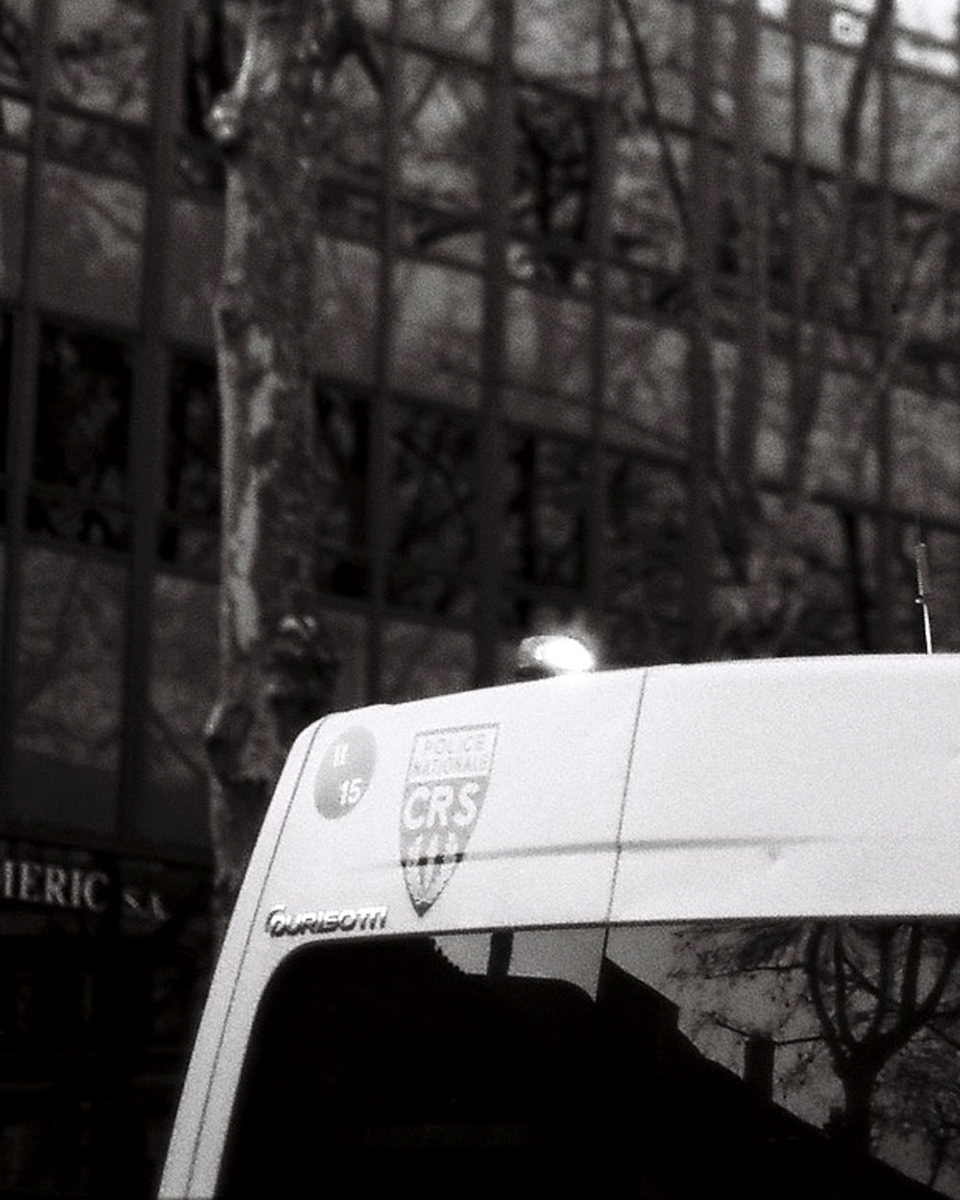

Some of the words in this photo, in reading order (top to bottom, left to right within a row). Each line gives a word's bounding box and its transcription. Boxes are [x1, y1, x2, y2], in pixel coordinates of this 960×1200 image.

[423, 732, 486, 756] POLICE
[339, 776, 364, 807] 15
[402, 781, 481, 831] CRS
